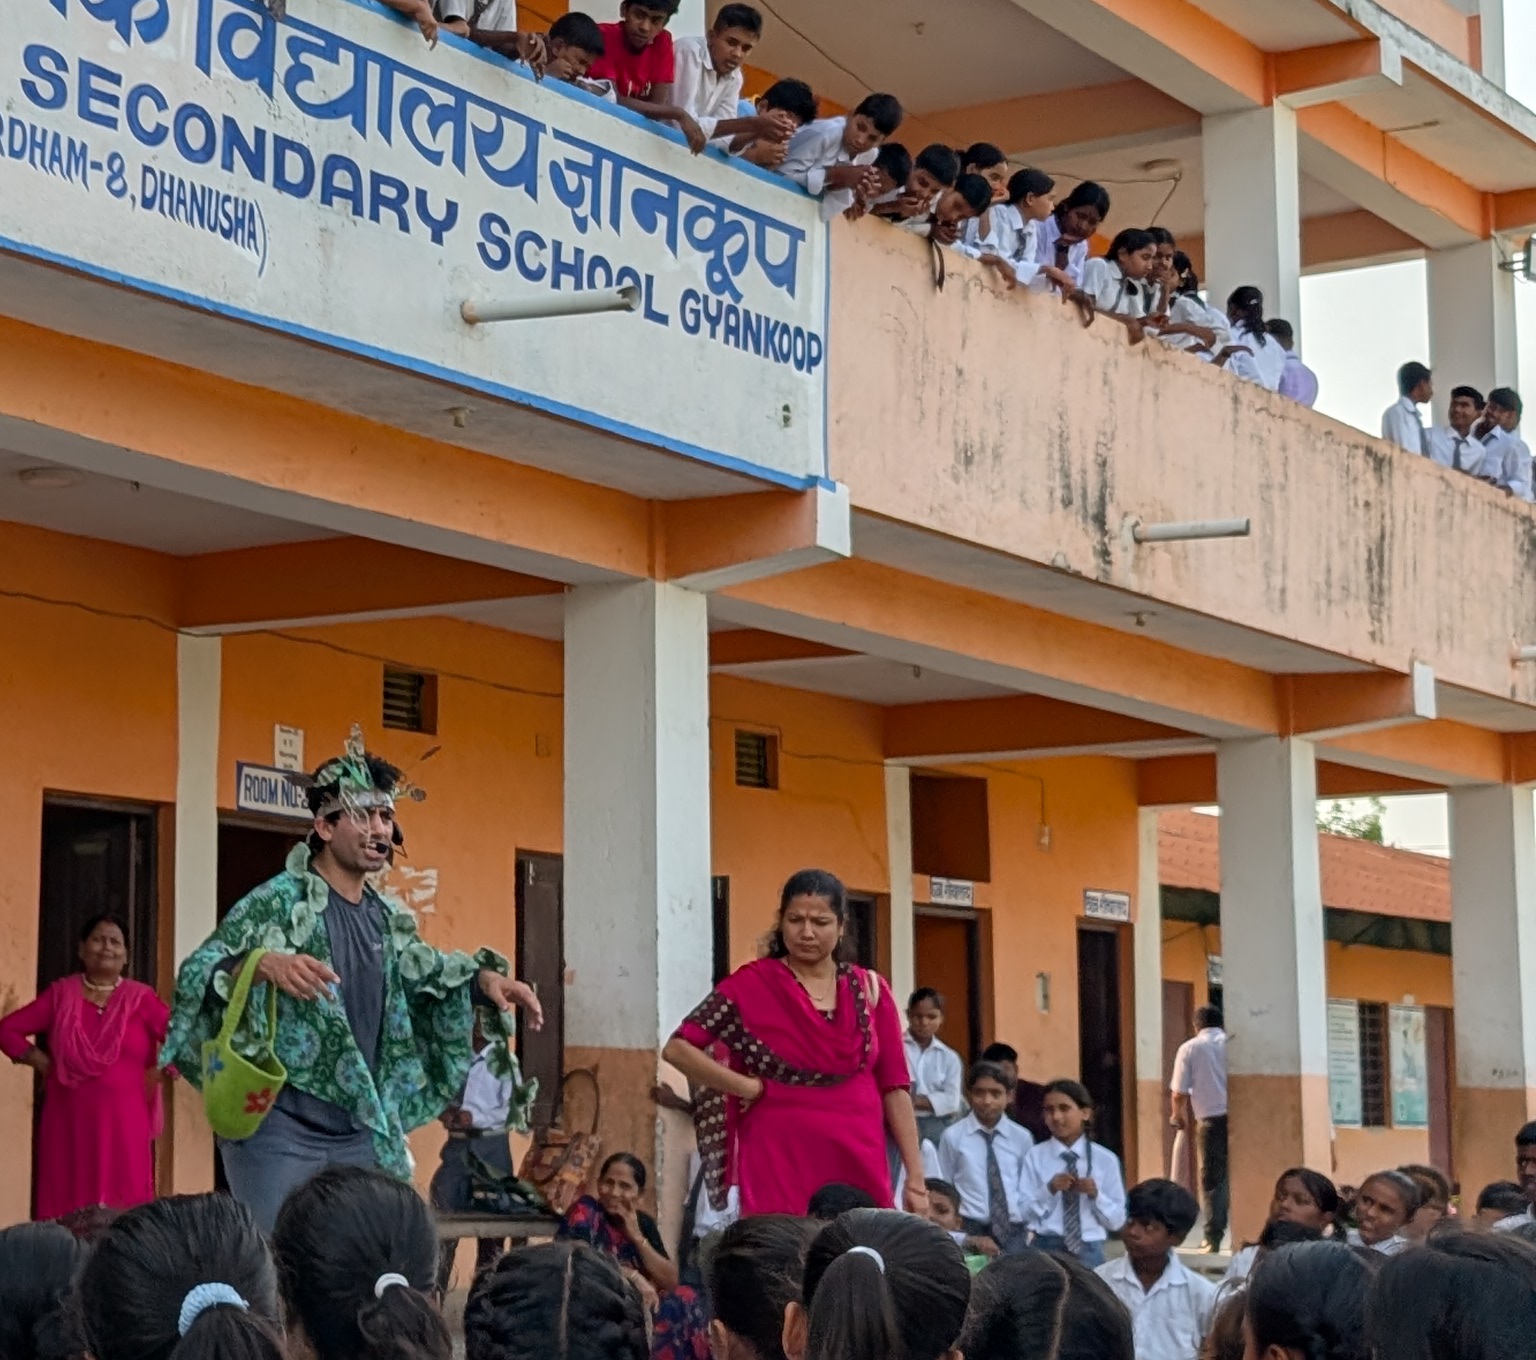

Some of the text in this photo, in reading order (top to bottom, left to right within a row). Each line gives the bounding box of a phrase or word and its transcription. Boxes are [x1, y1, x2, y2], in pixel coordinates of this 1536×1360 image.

[20, 43, 458, 246] SECONDARY
[680, 288, 822, 375] GYANKOOP
[549, 127, 806, 303] ज्ञानकूप
[243, 773, 278, 805] ROOM
